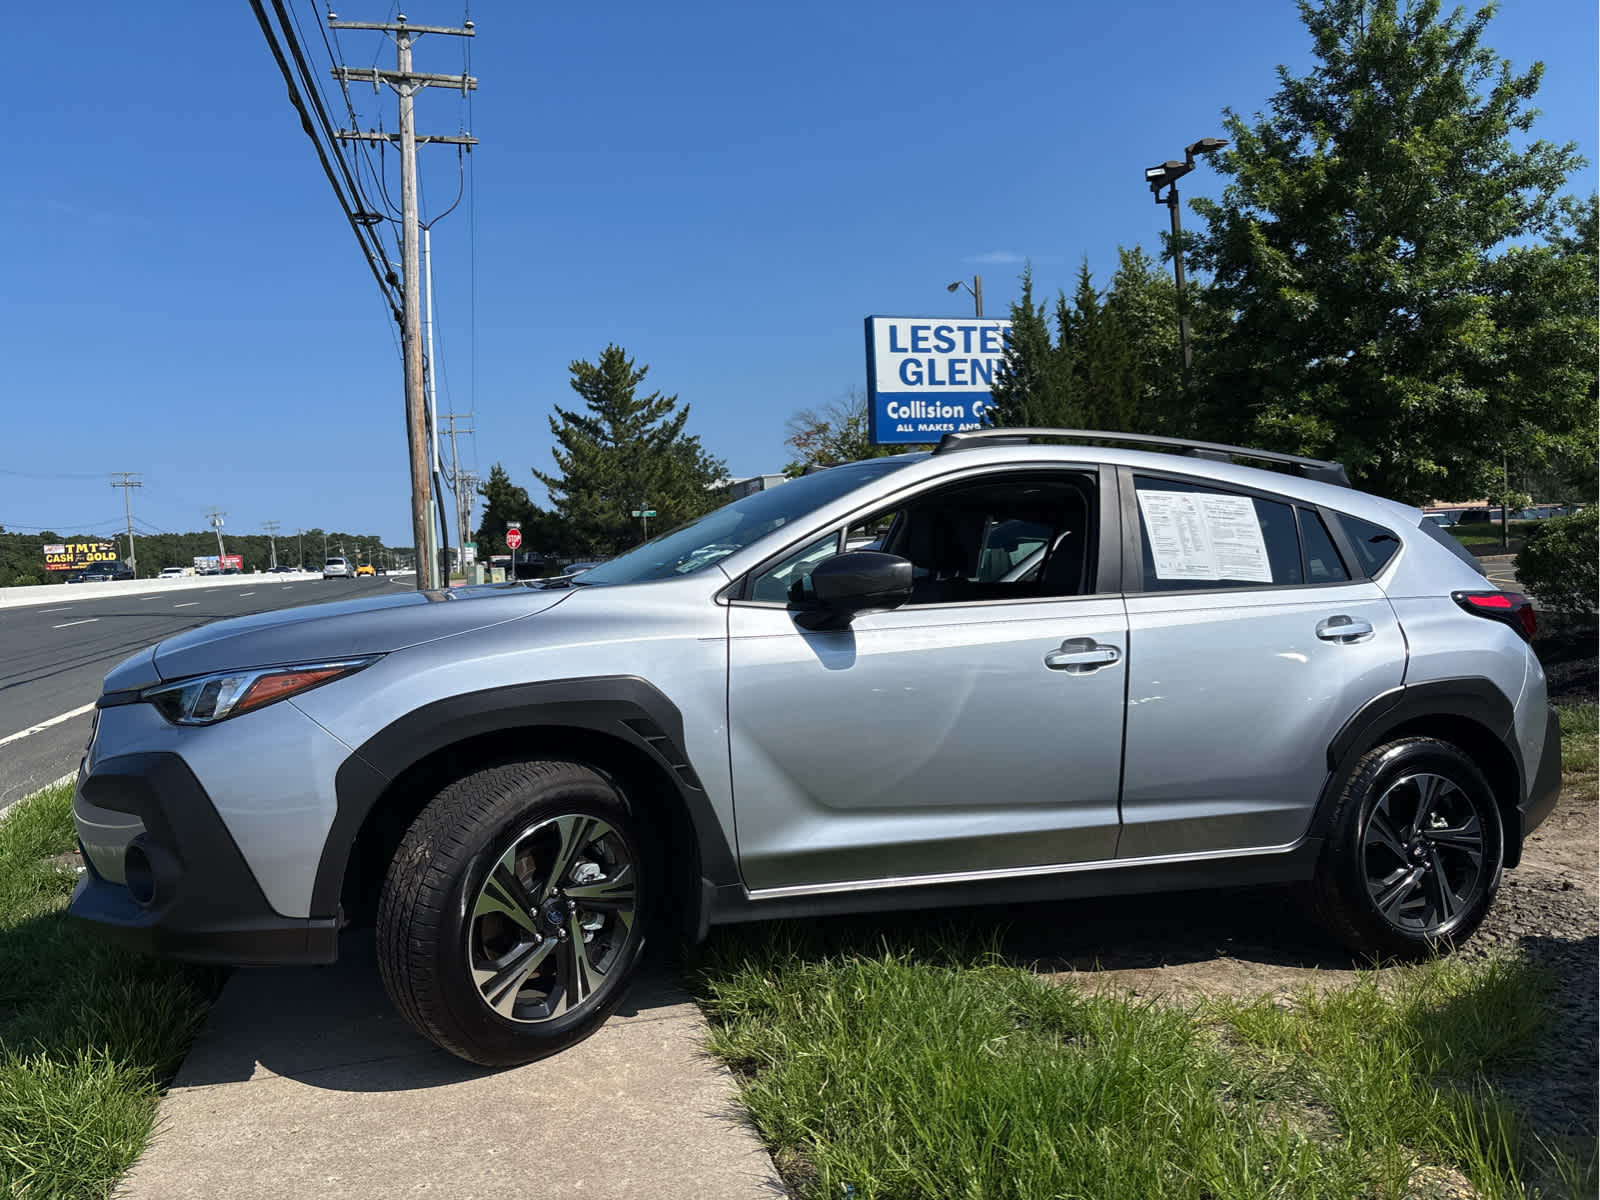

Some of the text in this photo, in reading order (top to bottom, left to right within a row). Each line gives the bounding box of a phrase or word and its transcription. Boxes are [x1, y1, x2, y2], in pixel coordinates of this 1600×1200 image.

[887, 401, 964, 419] Collision
[896, 424, 914, 432] ALL
[918, 424, 954, 432] MAKES
[507, 534, 521, 543] STOP
[65, 543, 98, 553] TMT
[46, 554, 74, 563] CASH
[86, 552, 117, 561] GOLD
